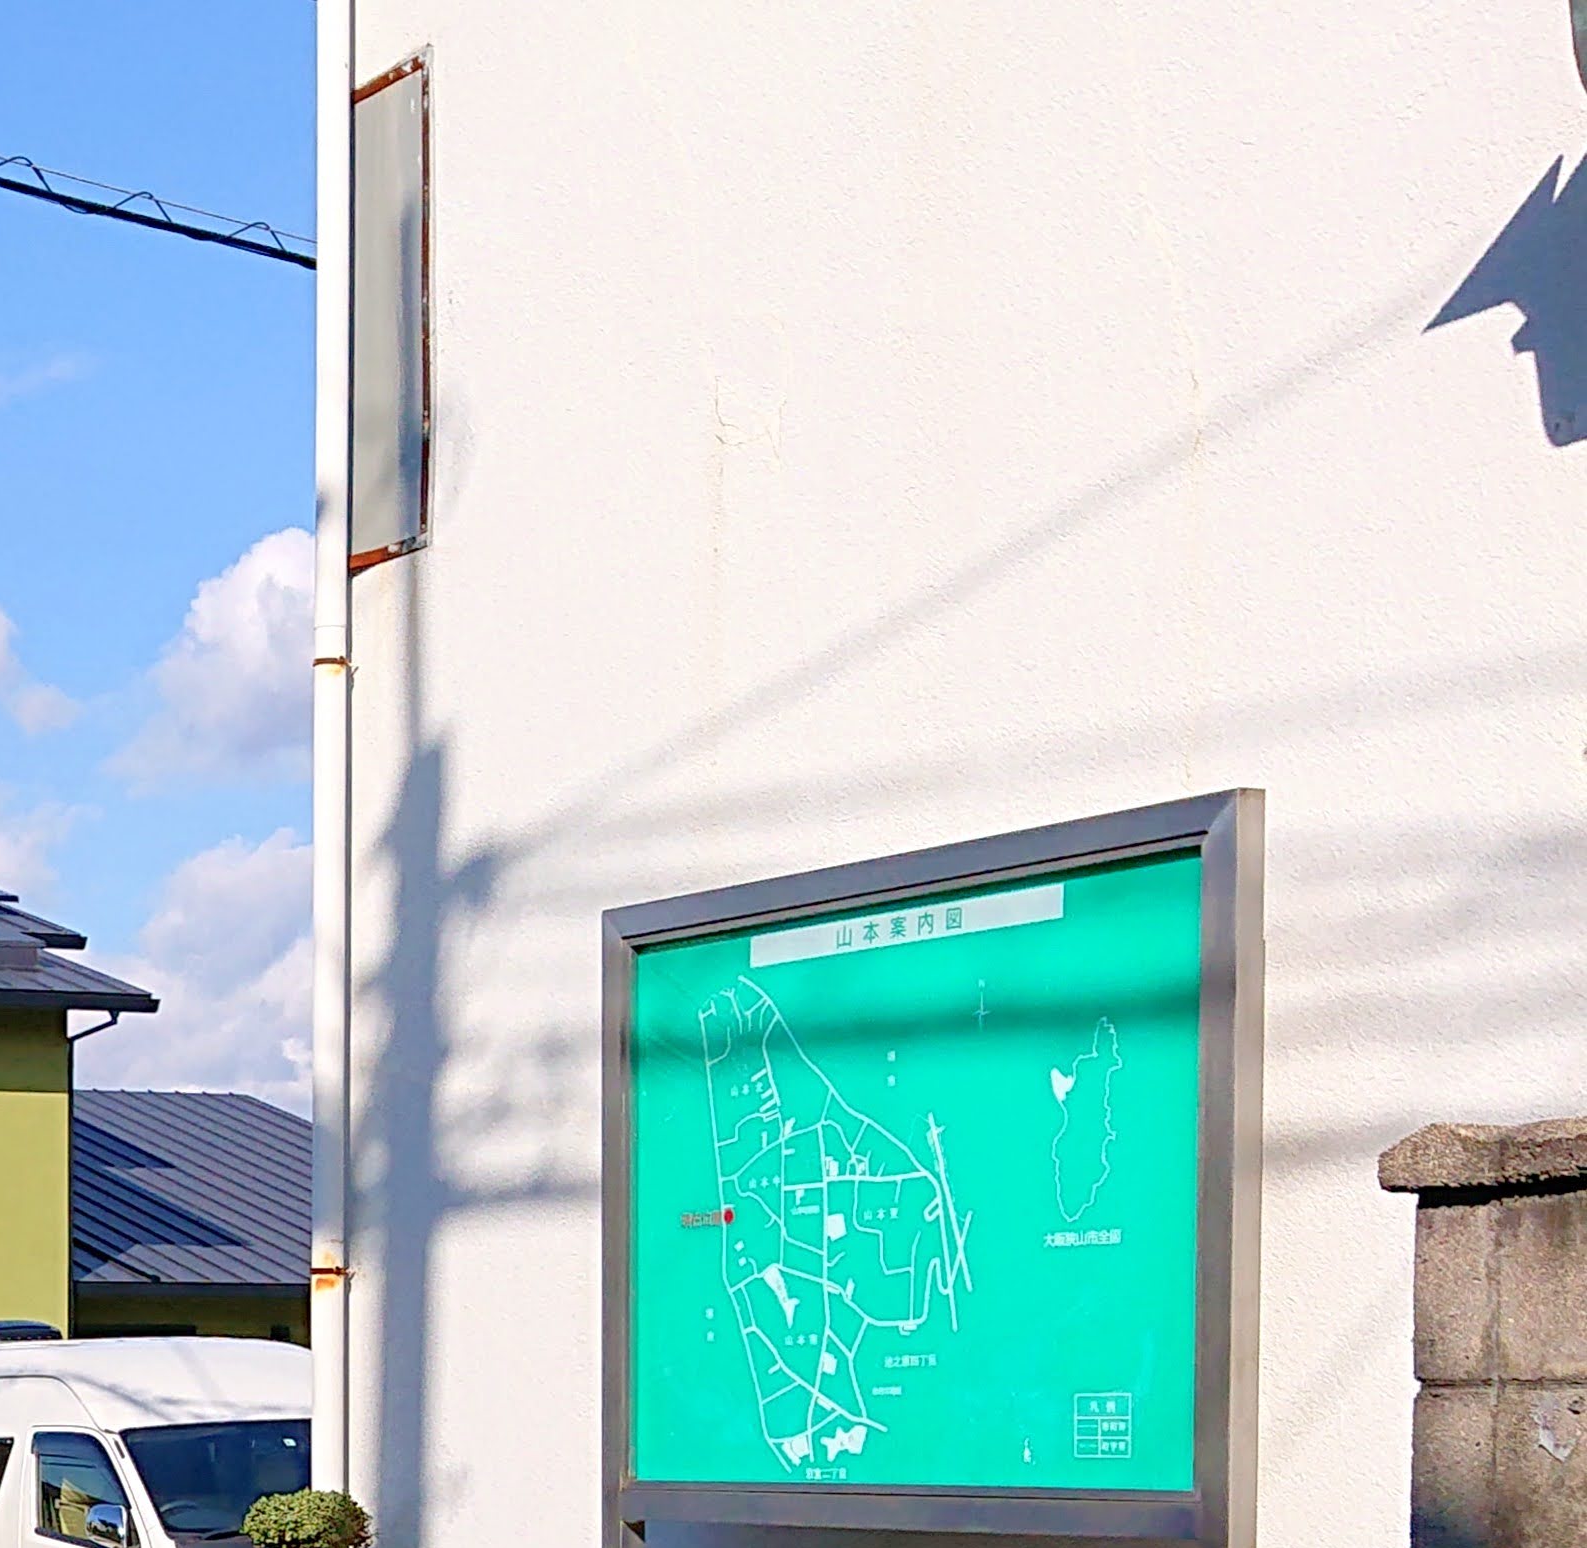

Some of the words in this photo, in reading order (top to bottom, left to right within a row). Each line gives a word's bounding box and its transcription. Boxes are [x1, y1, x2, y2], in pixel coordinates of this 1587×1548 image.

[836, 907, 963, 949] 山本案内図
